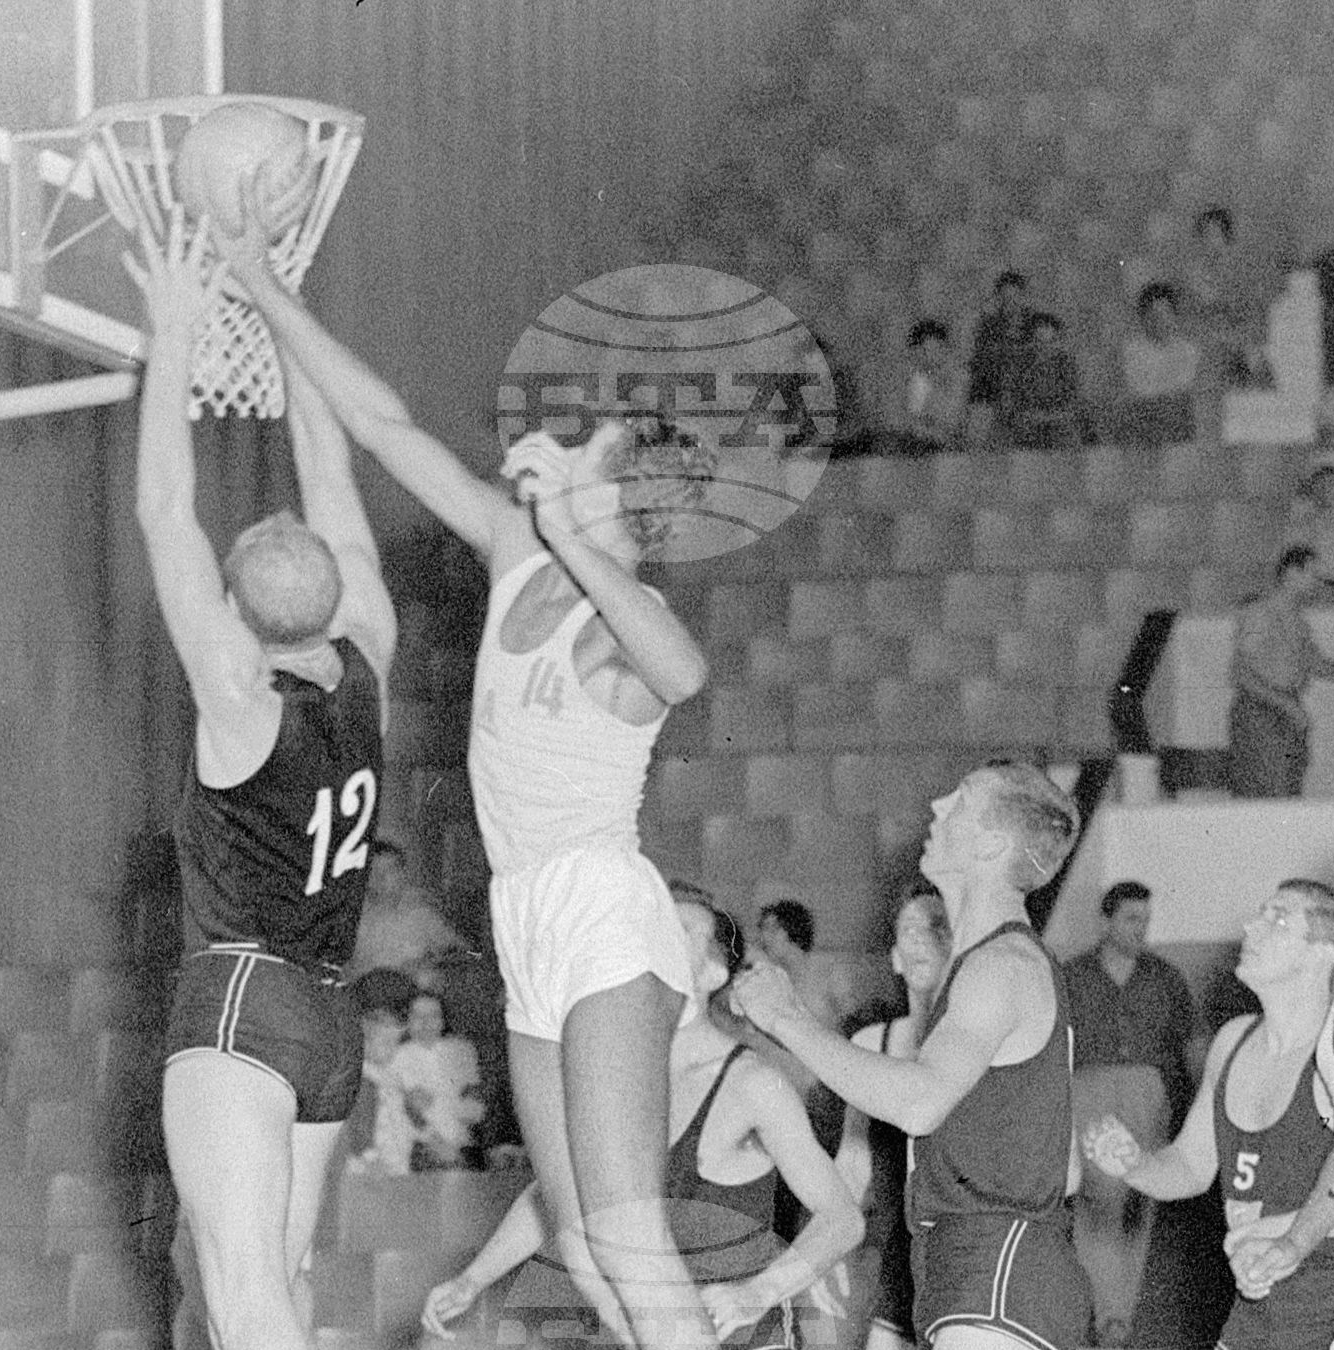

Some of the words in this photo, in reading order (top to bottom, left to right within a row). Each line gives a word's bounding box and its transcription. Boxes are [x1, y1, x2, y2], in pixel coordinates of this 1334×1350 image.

[521, 656, 565, 717] 14
[305, 768, 376, 895] 12
[1233, 1152, 1260, 1191] 5
